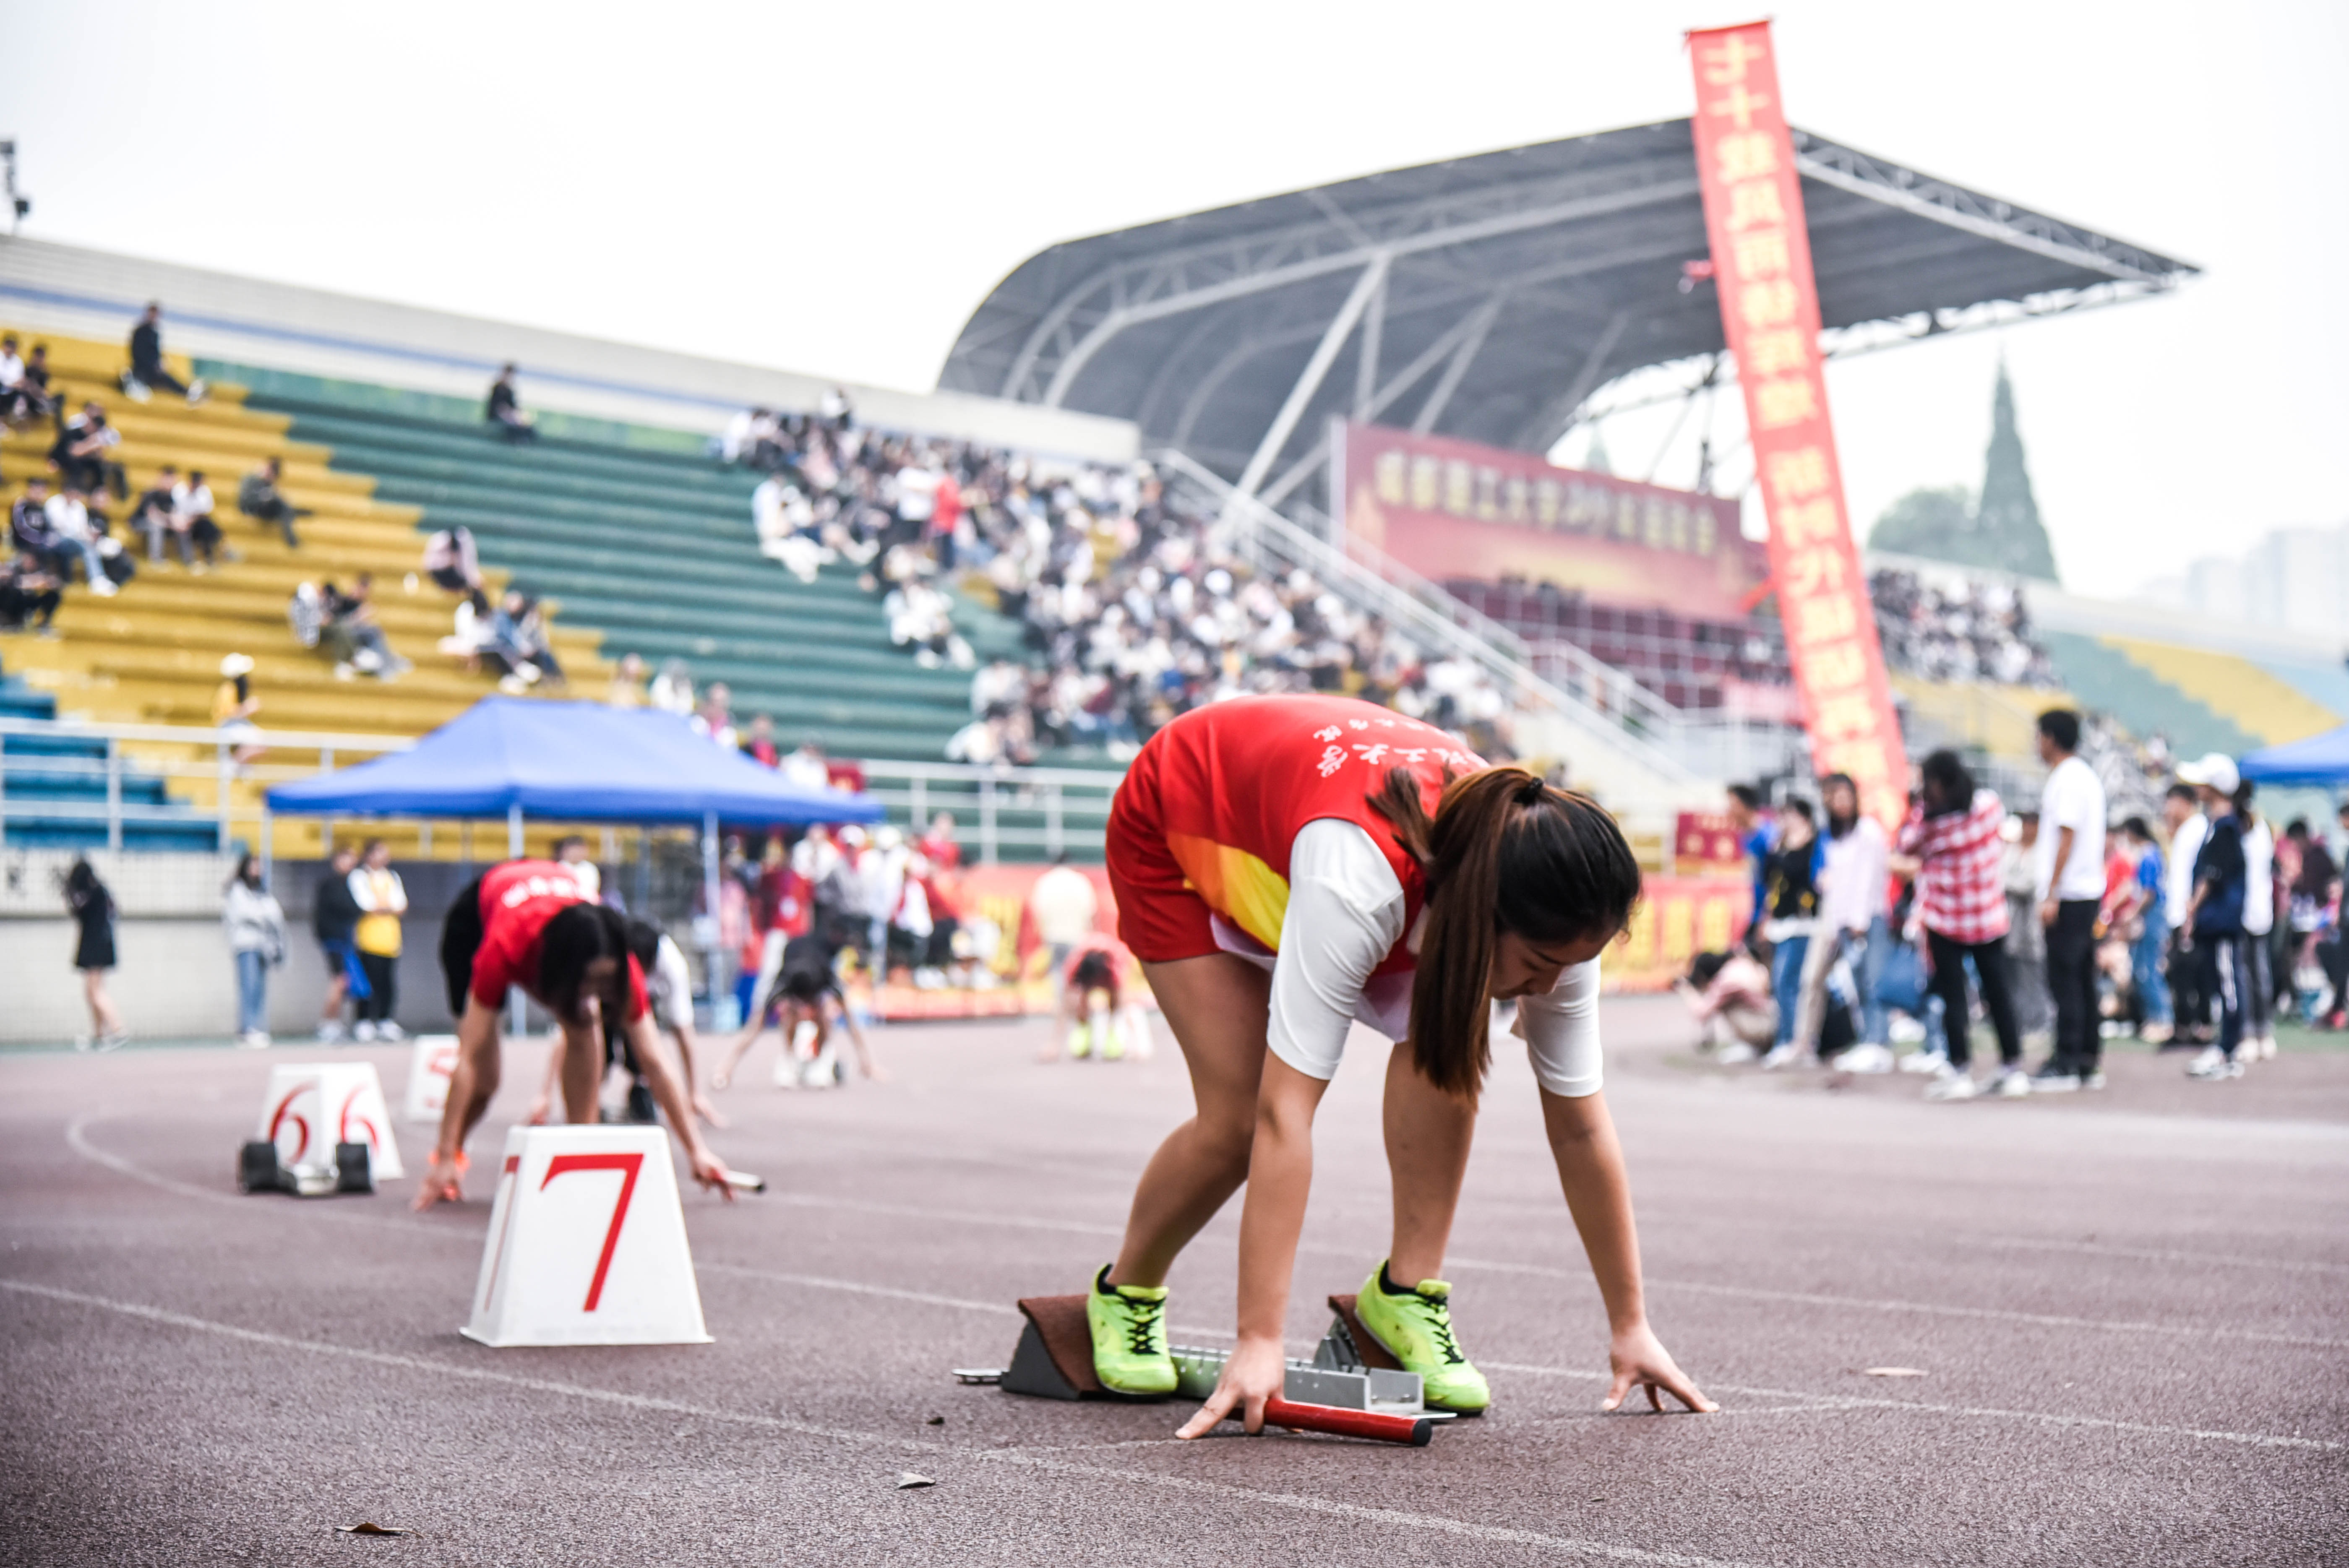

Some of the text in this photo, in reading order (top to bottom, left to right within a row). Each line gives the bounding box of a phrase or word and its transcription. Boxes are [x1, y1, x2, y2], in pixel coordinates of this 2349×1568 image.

[268, 1079, 318, 1164] 6
[339, 1083, 381, 1157] 6
[539, 1152, 645, 1313] 7
